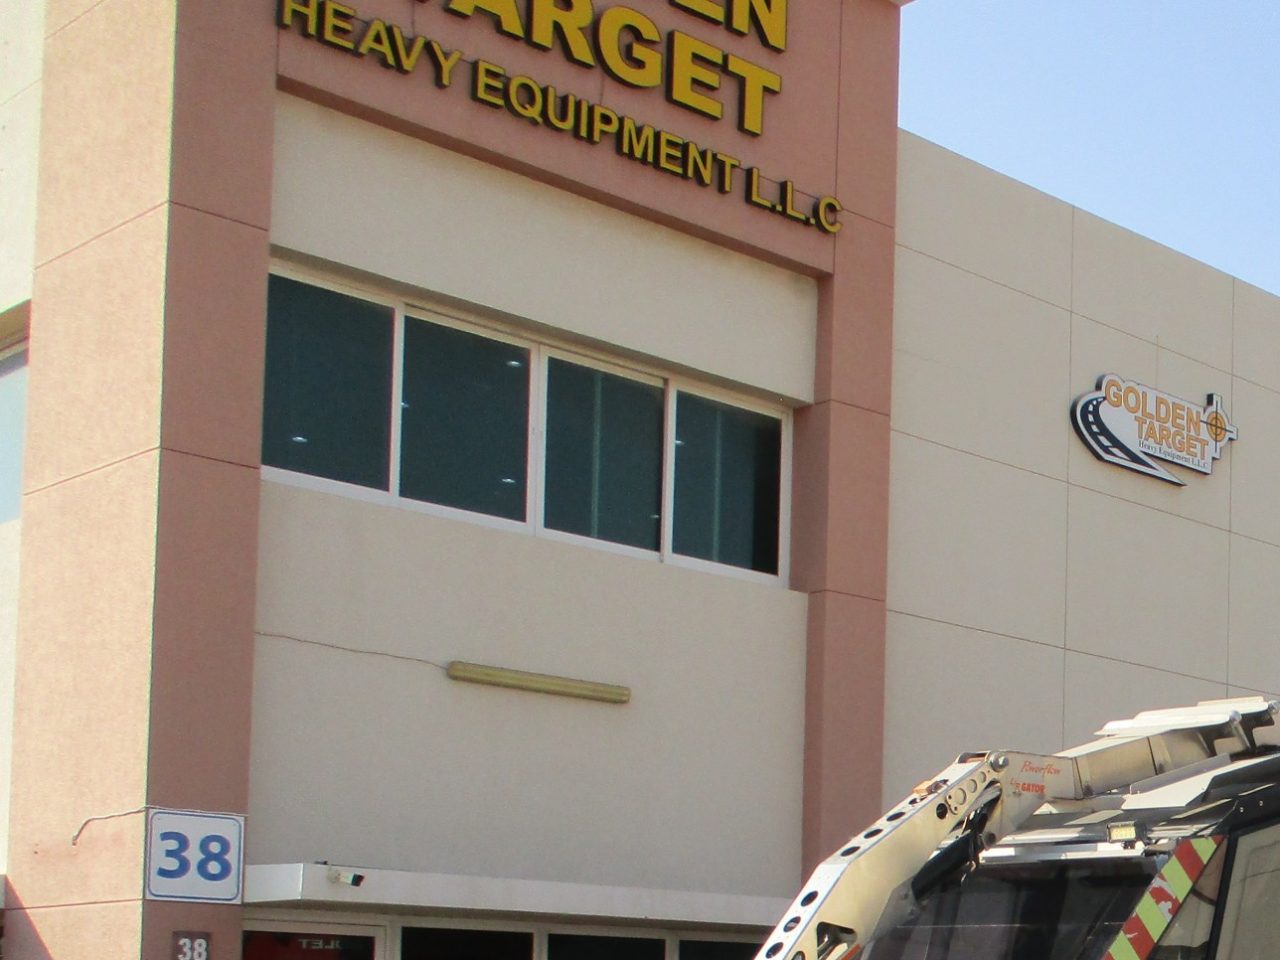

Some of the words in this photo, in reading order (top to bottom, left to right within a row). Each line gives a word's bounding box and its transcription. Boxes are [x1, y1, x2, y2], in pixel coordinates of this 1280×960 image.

[412, 0, 783, 136] RGET
[277, 0, 462, 89] HEAVY
[471, 58, 741, 194] EQUIPMENT
[745, 166, 844, 233] L.L.C
[1105, 379, 1201, 437] GOLDEN
[1135, 414, 1209, 460] TARGET
[157, 831, 232, 882] 38
